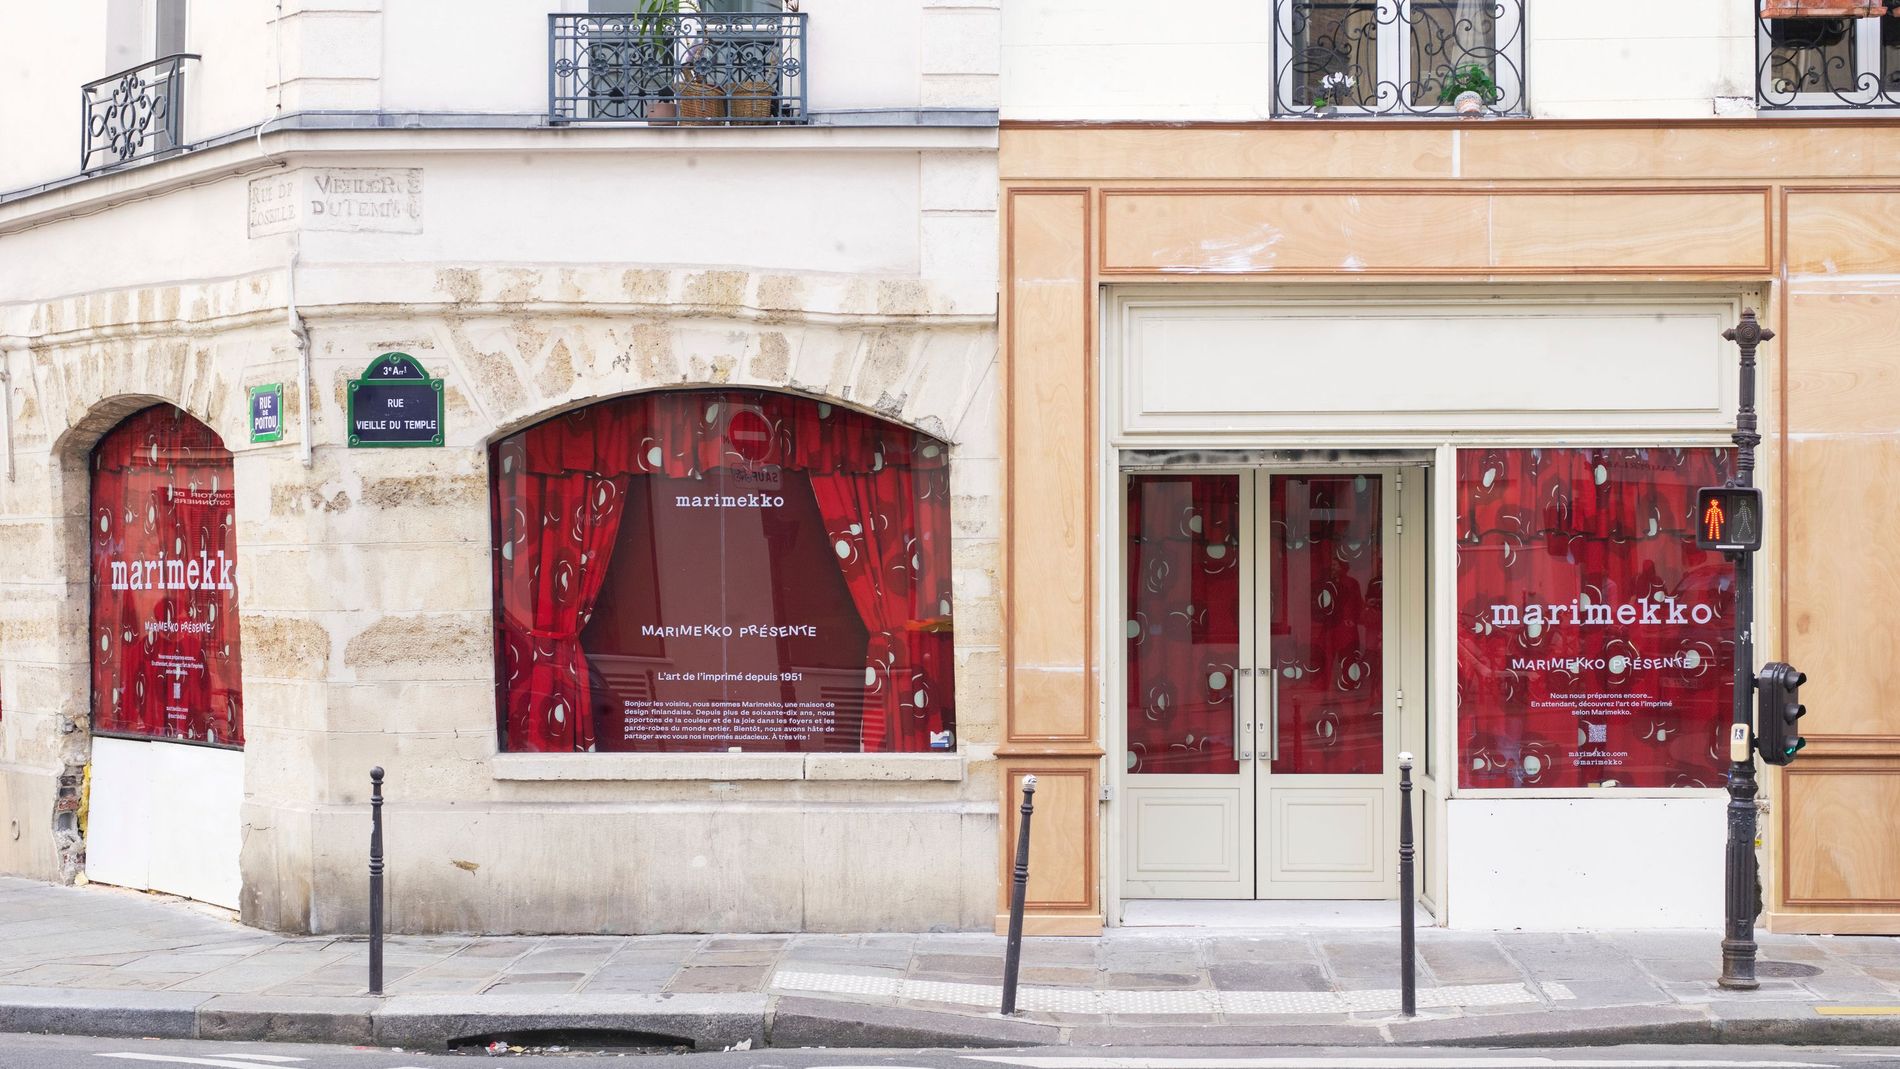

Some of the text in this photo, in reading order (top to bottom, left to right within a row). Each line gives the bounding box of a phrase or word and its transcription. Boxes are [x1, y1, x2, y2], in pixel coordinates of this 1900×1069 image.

[260, 396, 271, 410] RUE
[388, 399, 404, 408] RUE
[255, 416, 276, 430] POITOU
[356, 420, 436, 430] VIEILLE DU TEMPLE
[676, 494, 785, 508] marimekko
[111, 550, 233, 590] marimekk
[1490, 598, 1713, 625] marimekko
[181, 622, 211, 633] PRÉSENTE
[642, 624, 817, 638] MARIMEKKO PRÉSENTE
[1512, 656, 1692, 671] MARIMEKKO PRÉSENTE
[658, 672, 803, 683] L’art de l’imprimé depuis 1951
[624, 700, 652, 709] Bonjour
[665, 701, 692, 709] voisins,
[1542, 701, 1578, 709] attendant,
[624, 709, 649, 717] design
[1573, 759, 1623, 767] @marimekko
